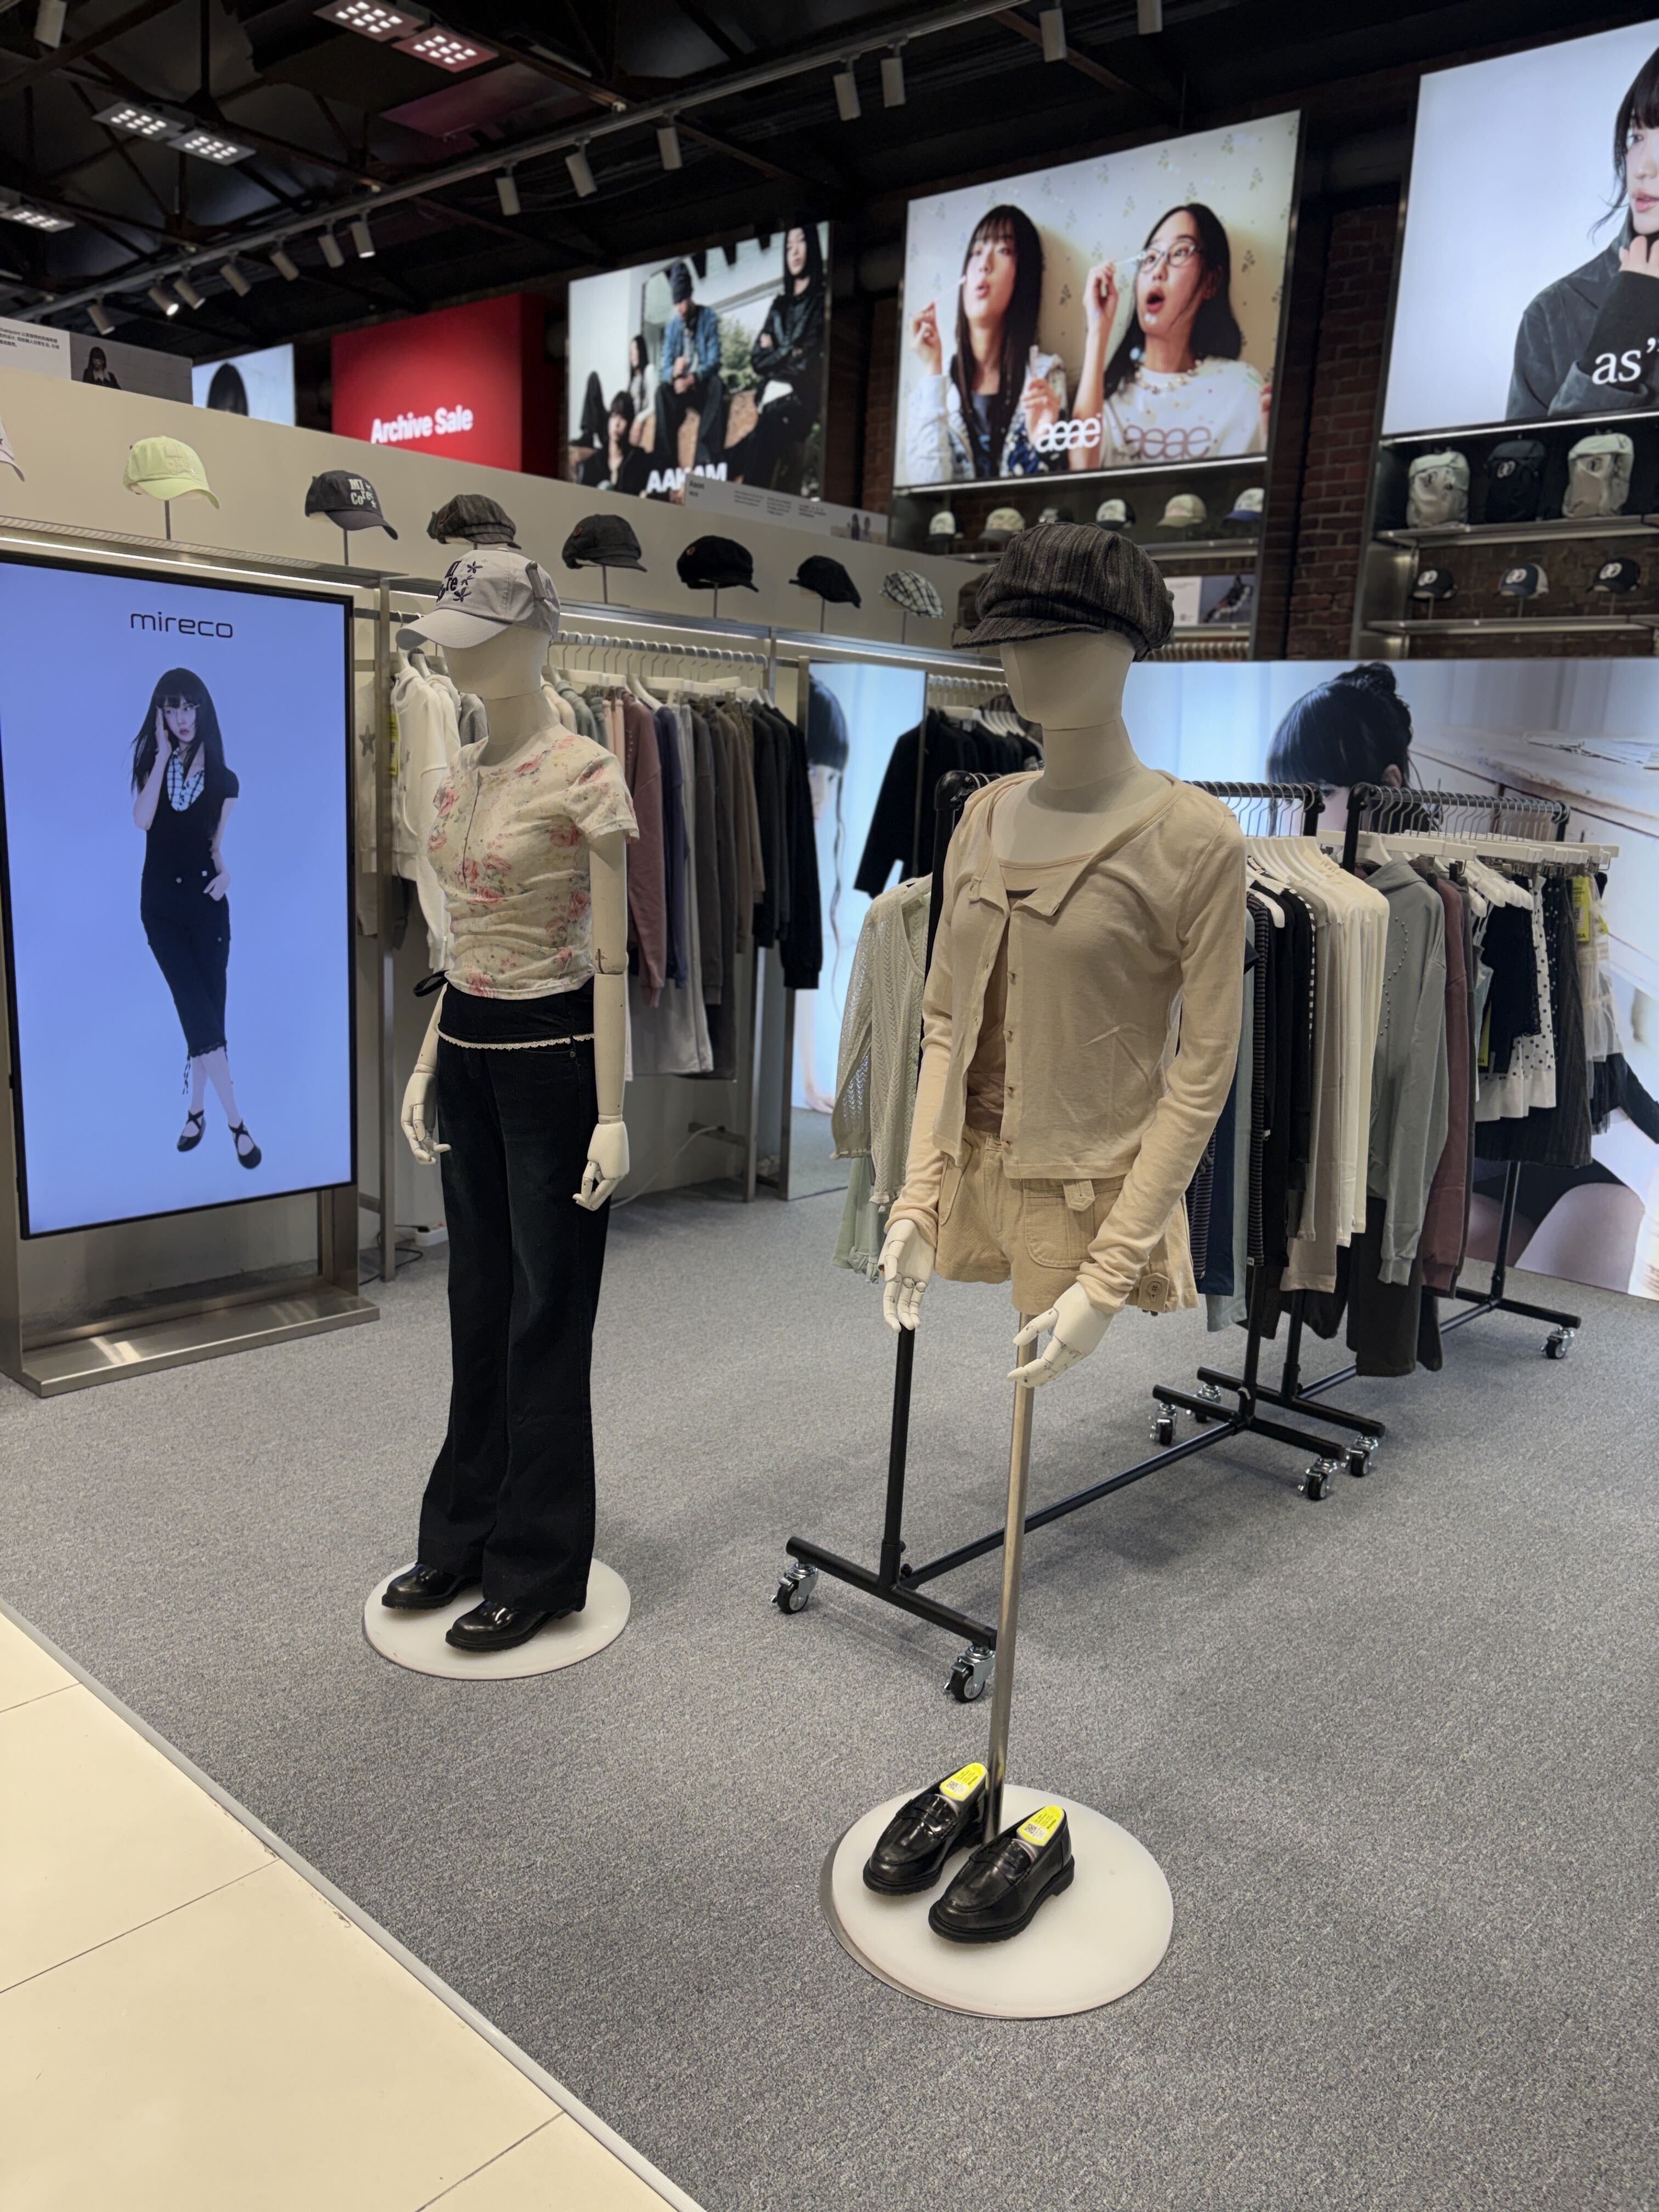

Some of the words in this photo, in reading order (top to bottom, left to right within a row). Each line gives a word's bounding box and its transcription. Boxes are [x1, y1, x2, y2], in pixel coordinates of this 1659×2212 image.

[370, 411, 434, 444] Archive
[434, 404, 473, 435] Sale
[131, 611, 233, 638] mireco
